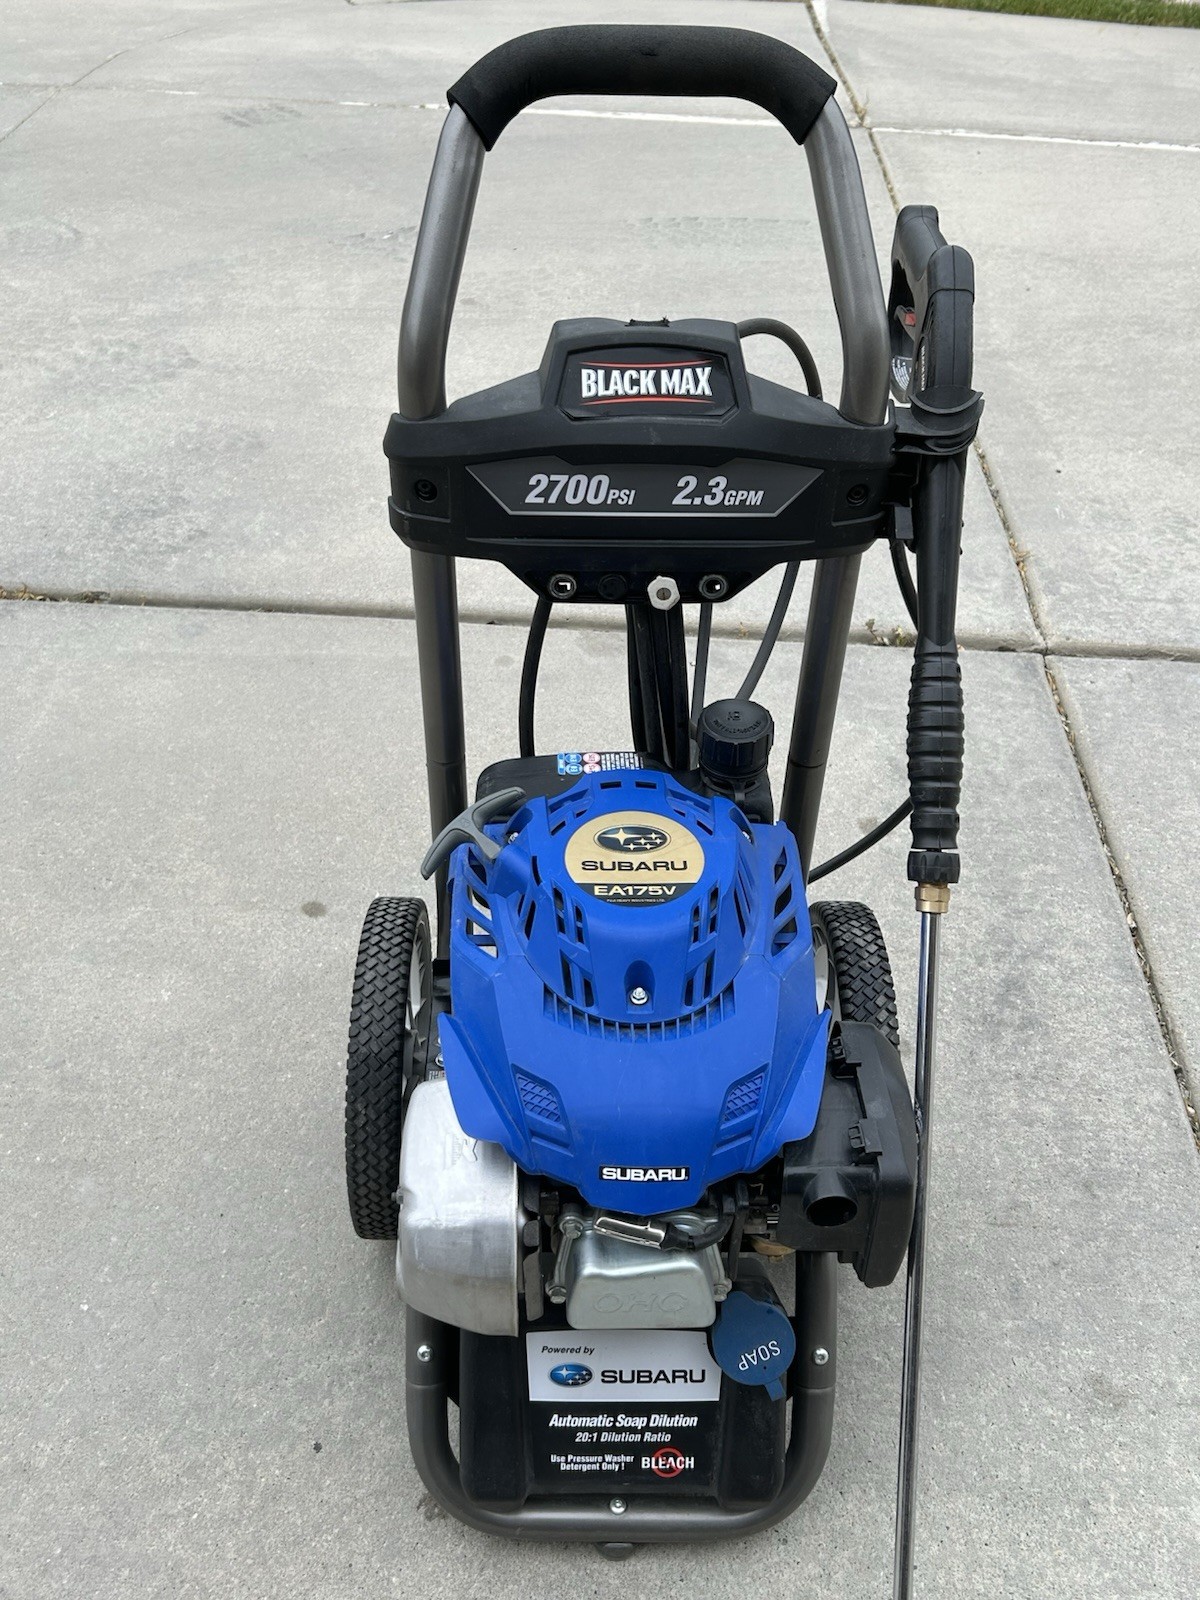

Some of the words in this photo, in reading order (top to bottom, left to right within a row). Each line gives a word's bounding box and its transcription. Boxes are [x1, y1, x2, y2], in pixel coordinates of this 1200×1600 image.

[581, 368, 657, 398] BLACK
[661, 367, 713, 396] MAX
[581, 860, 688, 871] SUBARU
[594, 885, 676, 896] EA175V
[541, 1346, 581, 1354] Powered
[583, 1346, 595, 1355] by
[738, 1340, 781, 1371] SOAP
[600, 1369, 706, 1384] SUBARU
[549, 1414, 614, 1427] Automatic
[616, 1414, 647, 1429] Soap
[650, 1414, 698, 1427] Dilution
[575, 1432, 597, 1442] 20:1
[601, 1432, 641, 1442] Dilution
[643, 1432, 671, 1442] Ratio
[604, 1454, 634, 1462] Washer
[641, 1457, 695, 1469] BLEACH
[560, 1463, 600, 1471] Detergent
[602, 1463, 619, 1471] Only
